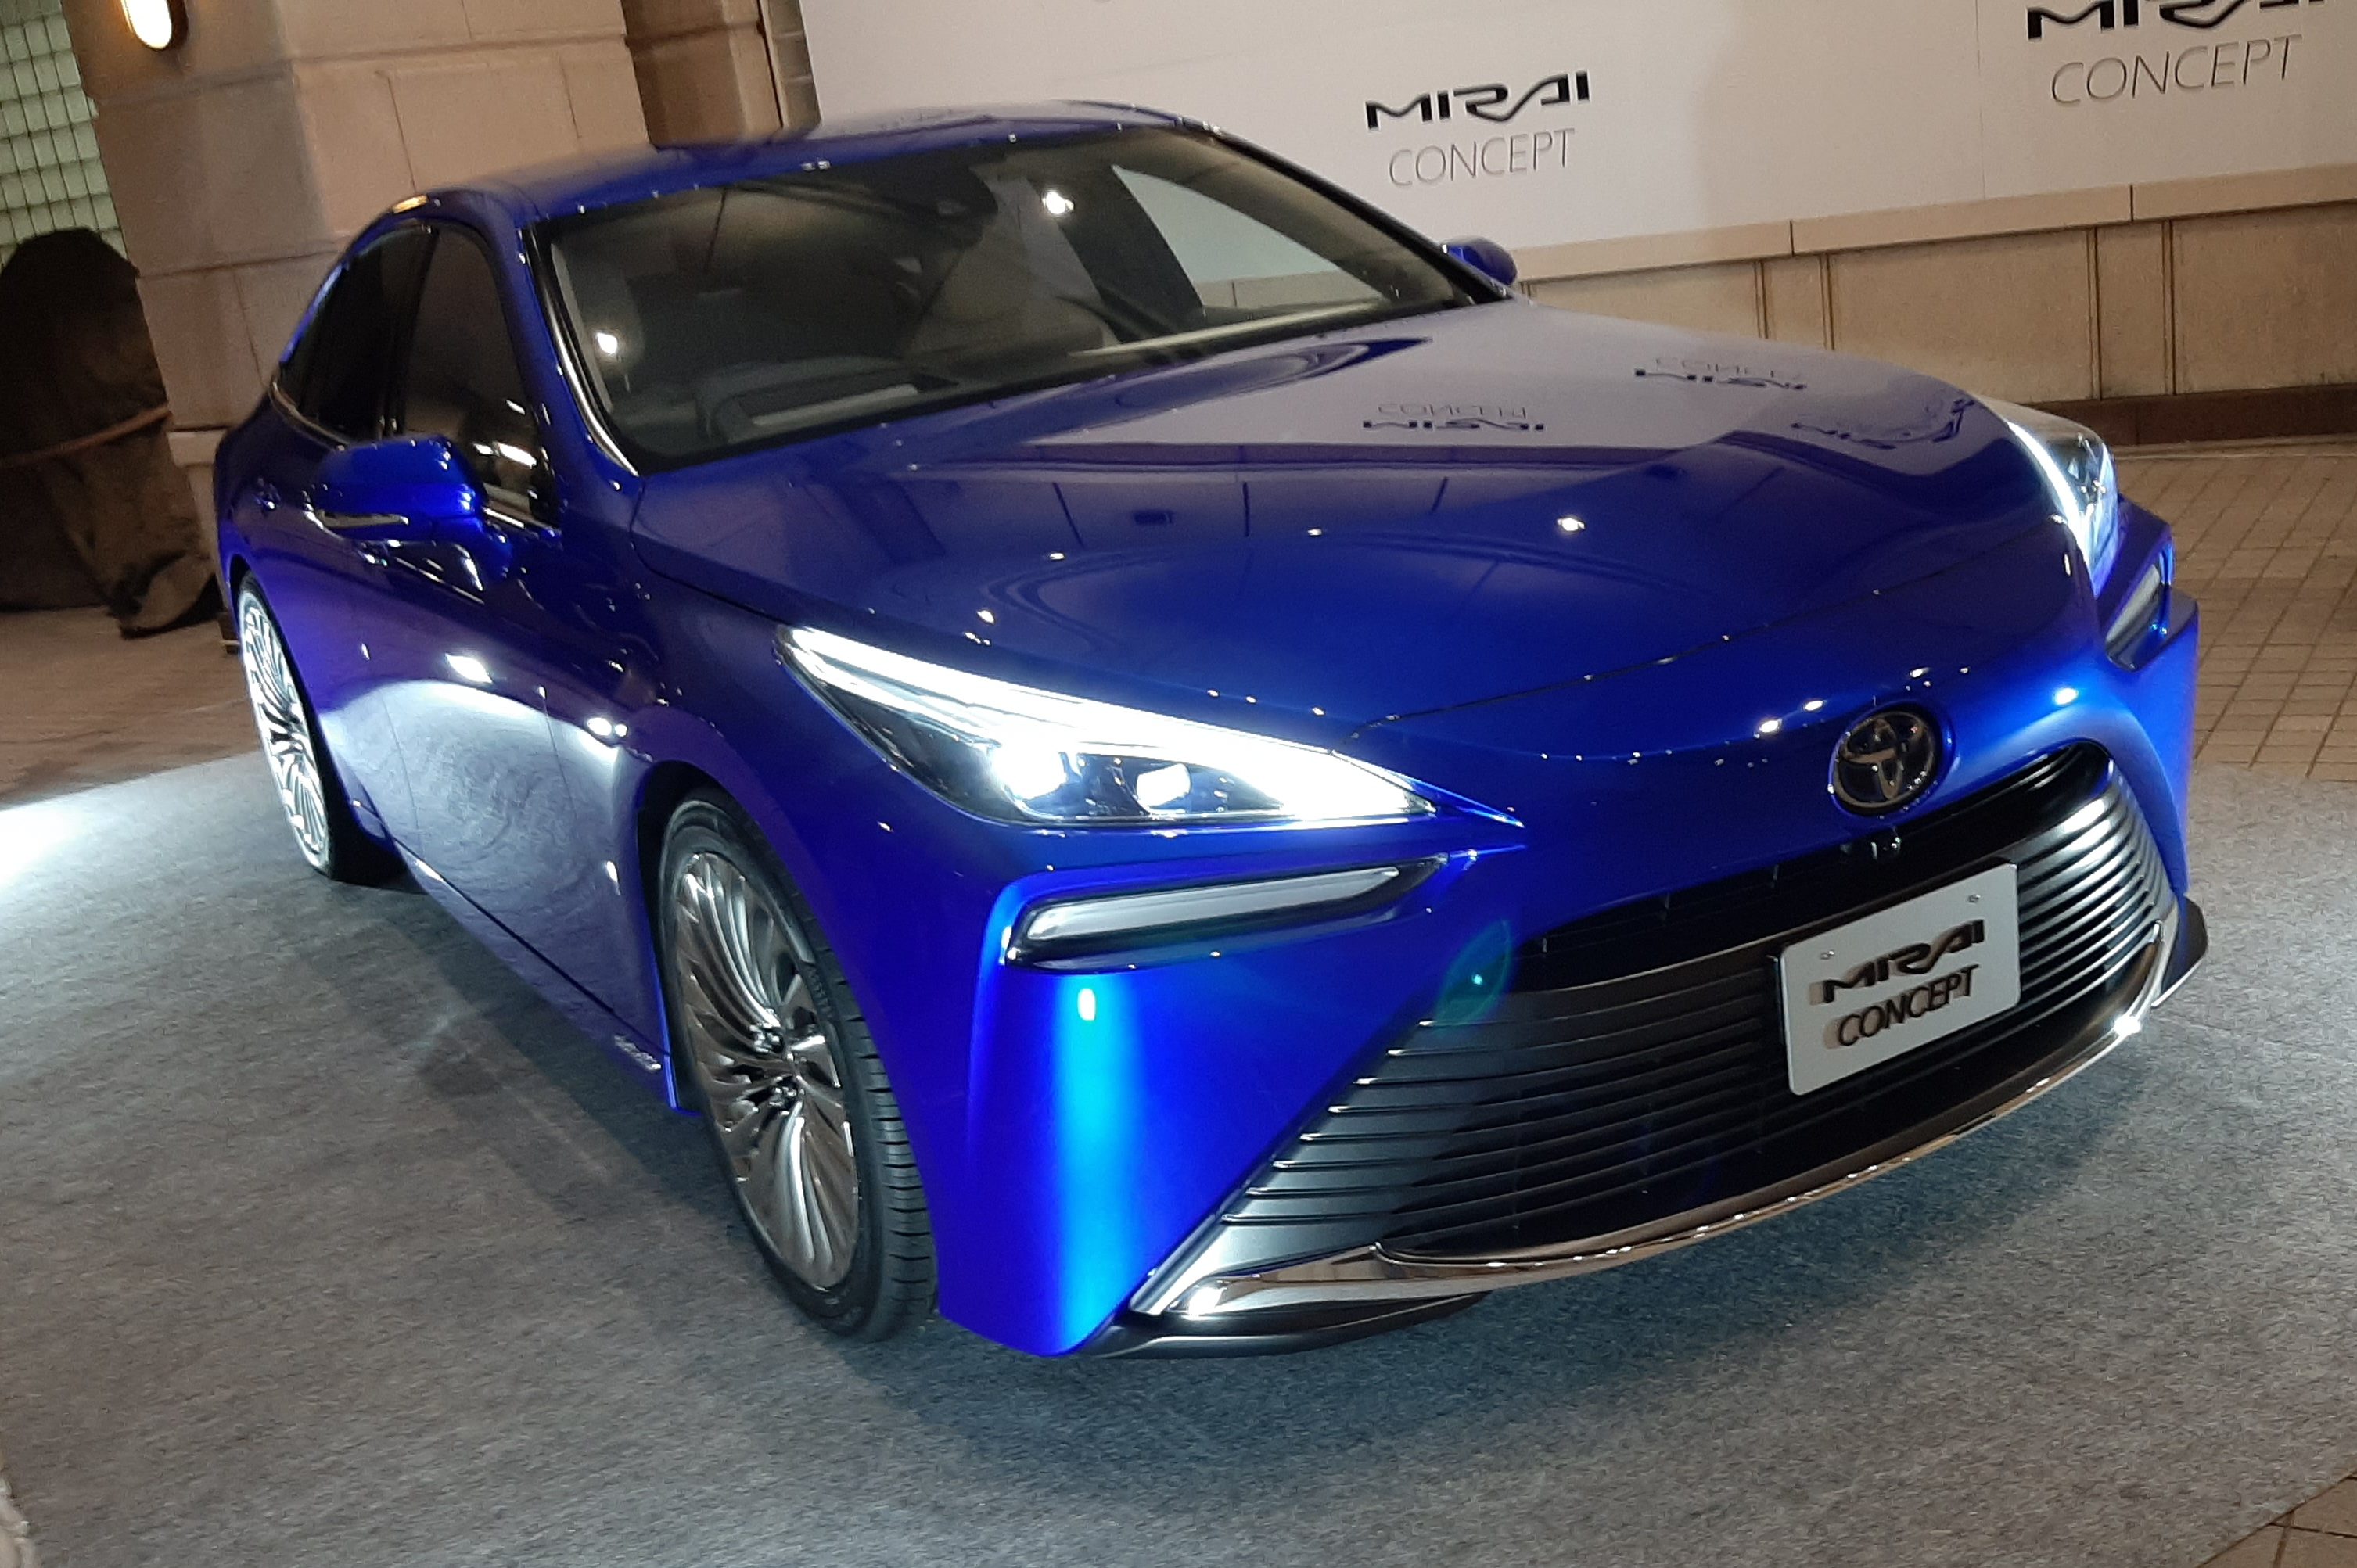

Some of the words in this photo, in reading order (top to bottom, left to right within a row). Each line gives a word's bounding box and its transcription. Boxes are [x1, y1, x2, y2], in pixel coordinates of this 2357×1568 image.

[2028, 0, 2326, 39] MIR
[1365, 70, 1590, 130] MIRAI
[2051, 34, 2303, 106] CONCEPT
[1389, 127, 1576, 187] CONCEPT
[1820, 919, 1986, 1005] MIRAI
[1835, 963, 1980, 1047] CONCEPT
